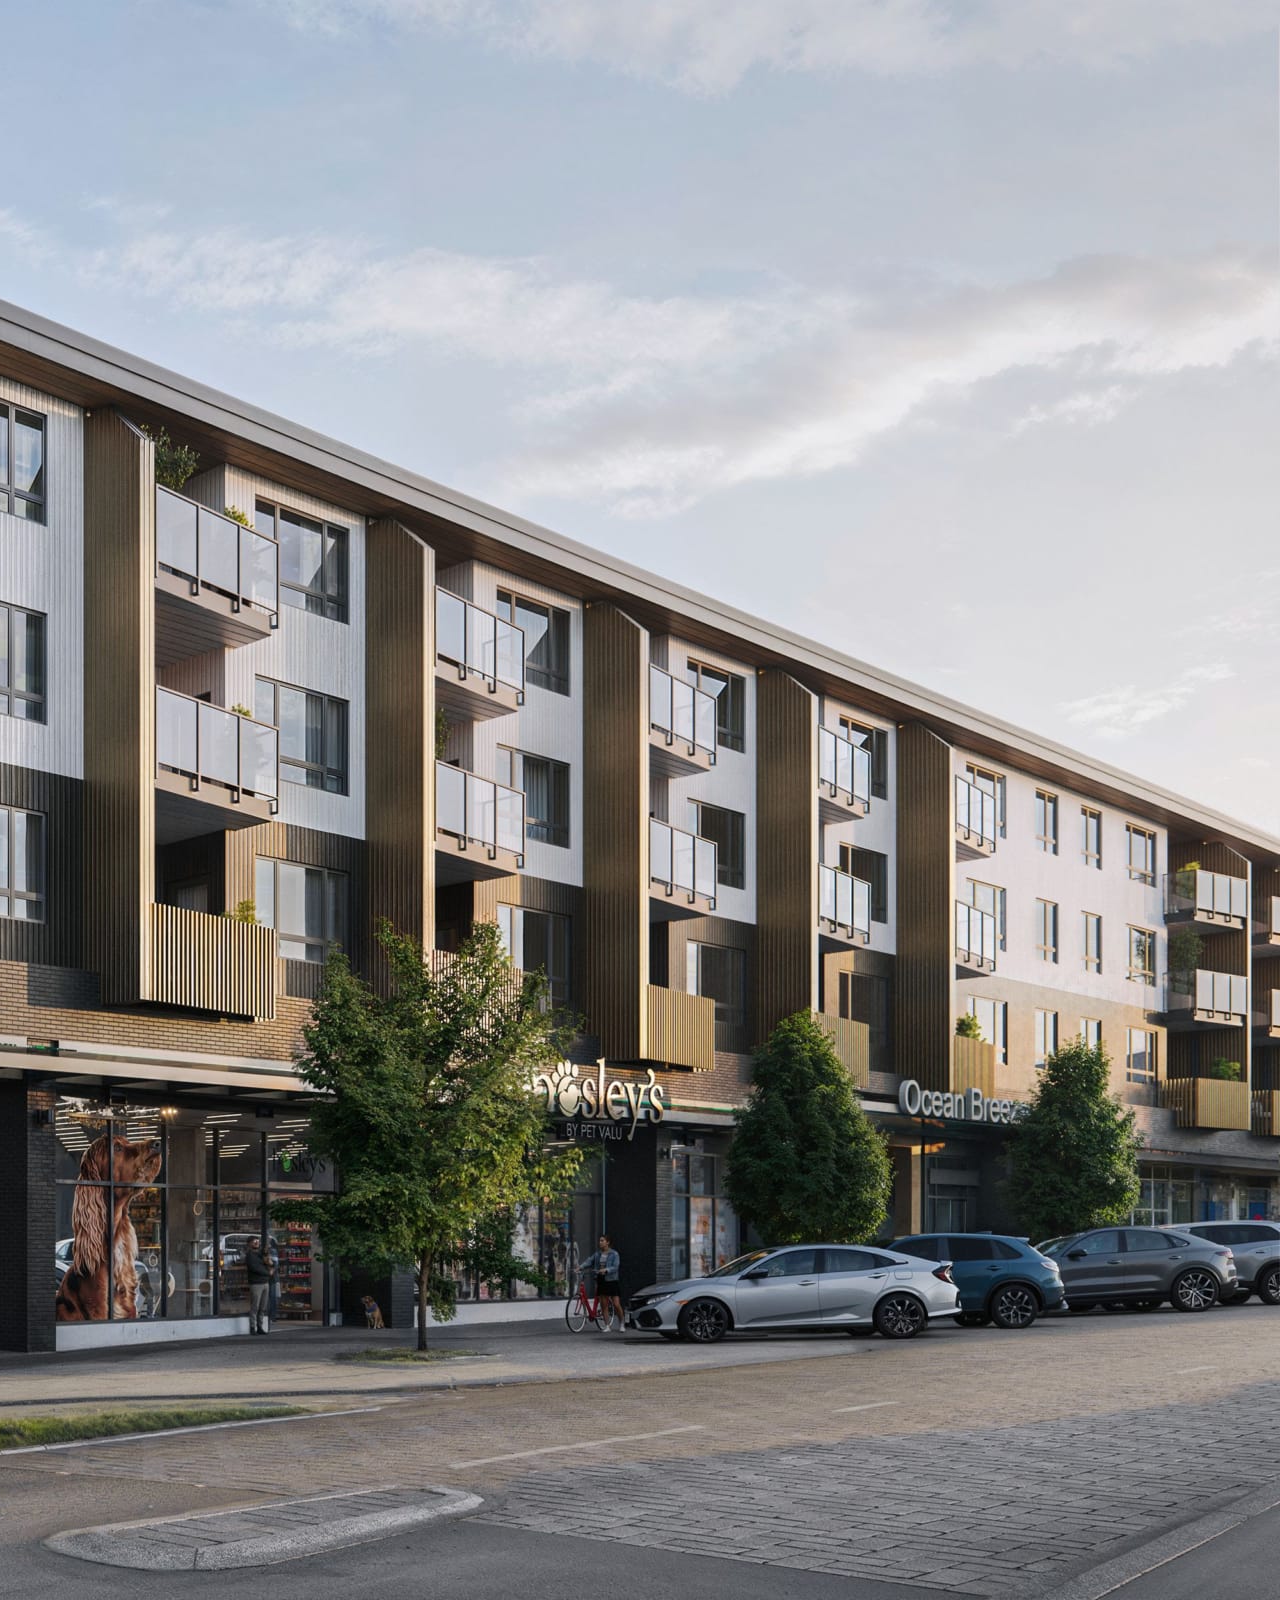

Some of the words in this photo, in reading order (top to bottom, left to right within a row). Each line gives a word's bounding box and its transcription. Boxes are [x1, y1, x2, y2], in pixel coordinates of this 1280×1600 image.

[898, 1079, 965, 1120] Ocean
[566, 1123, 578, 1137] BY
[580, 1124, 596, 1139] PET
[598, 1125, 623, 1140] VALU
